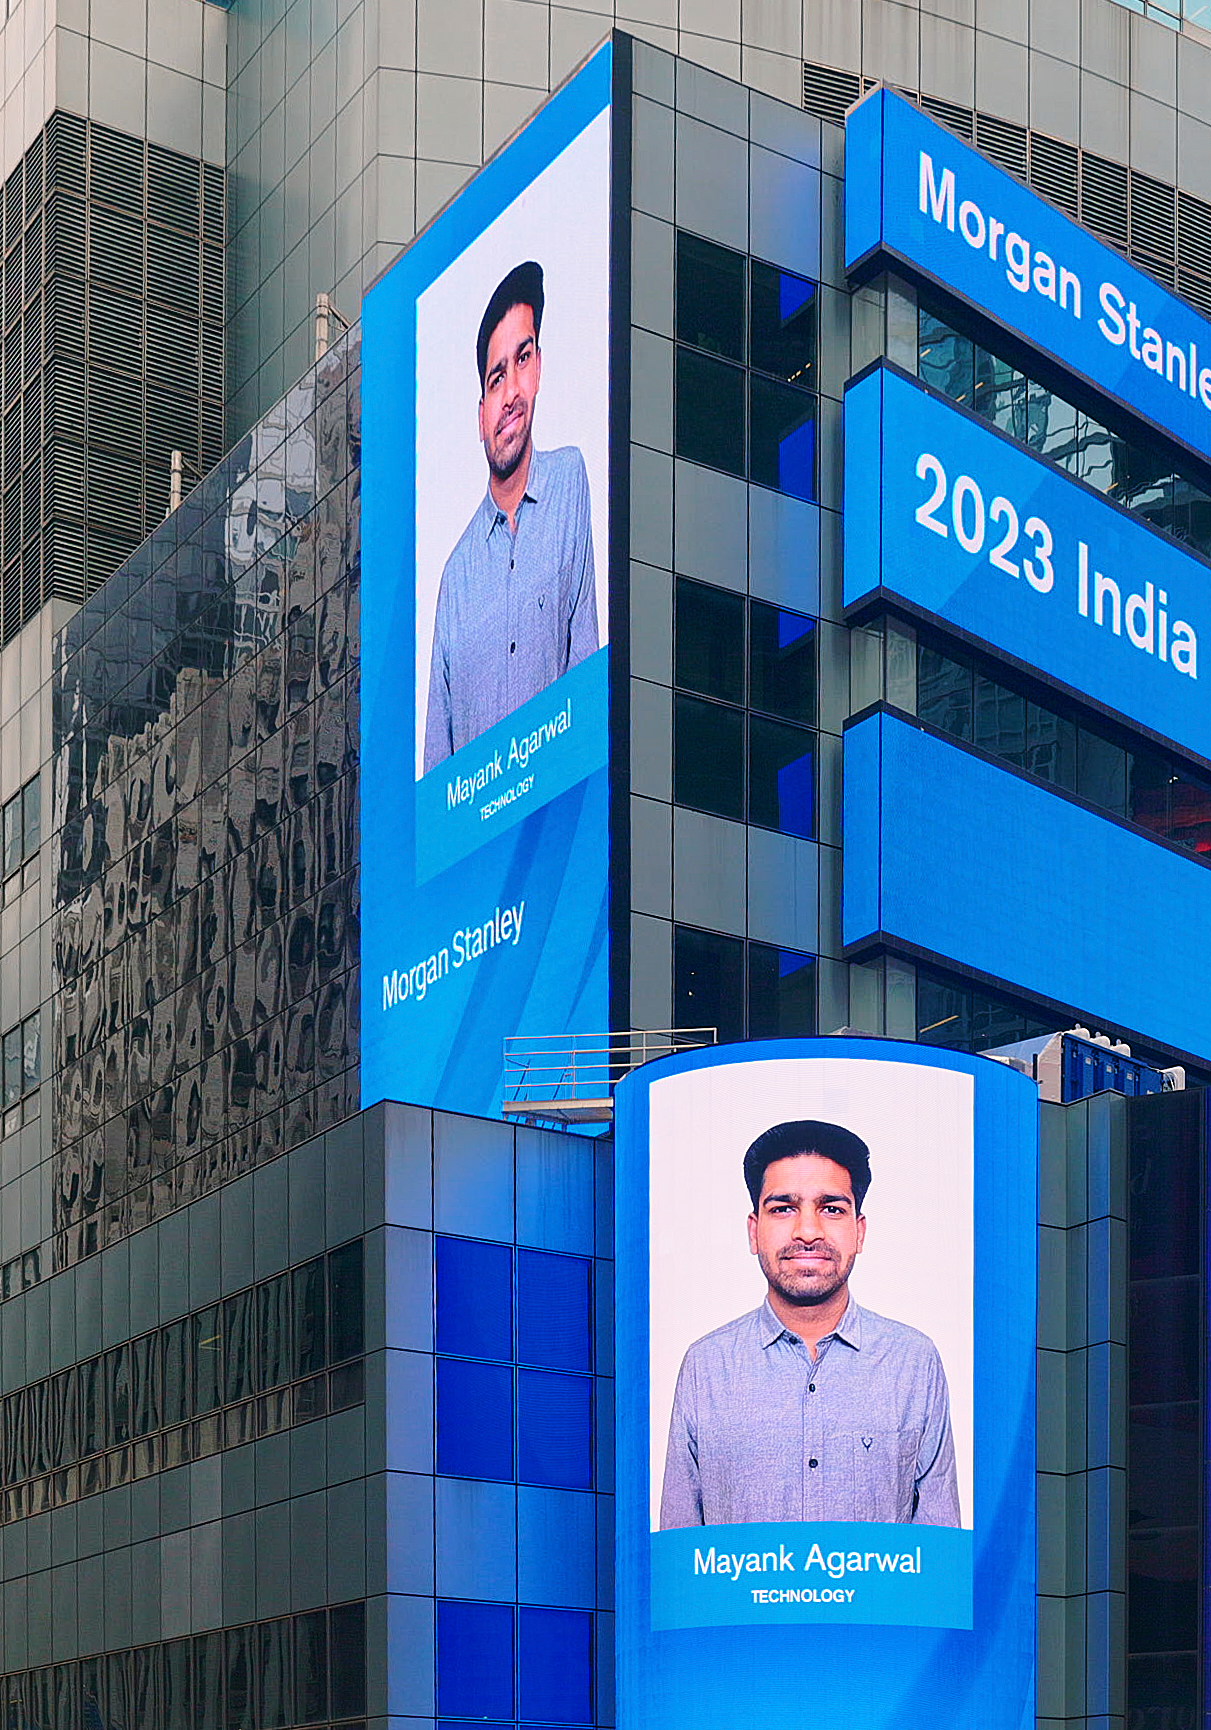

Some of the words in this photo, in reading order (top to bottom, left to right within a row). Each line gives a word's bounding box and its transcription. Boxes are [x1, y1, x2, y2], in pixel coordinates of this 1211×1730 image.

[919, 151, 1081, 319] Morgan
[916, 453, 1054, 594] 2023
[1078, 542, 1198, 679] India
[447, 751, 503, 811] Mayank
[507, 698, 572, 771] Agarwal
[479, 774, 535, 822] TECHNOLOGY
[383, 948, 449, 1011] Morgan
[452, 901, 525, 969] Stanley
[694, 1544, 796, 1582] Mayank
[804, 1543, 921, 1579] Agarwal
[751, 1589, 855, 1604] TECHNOLOGY
